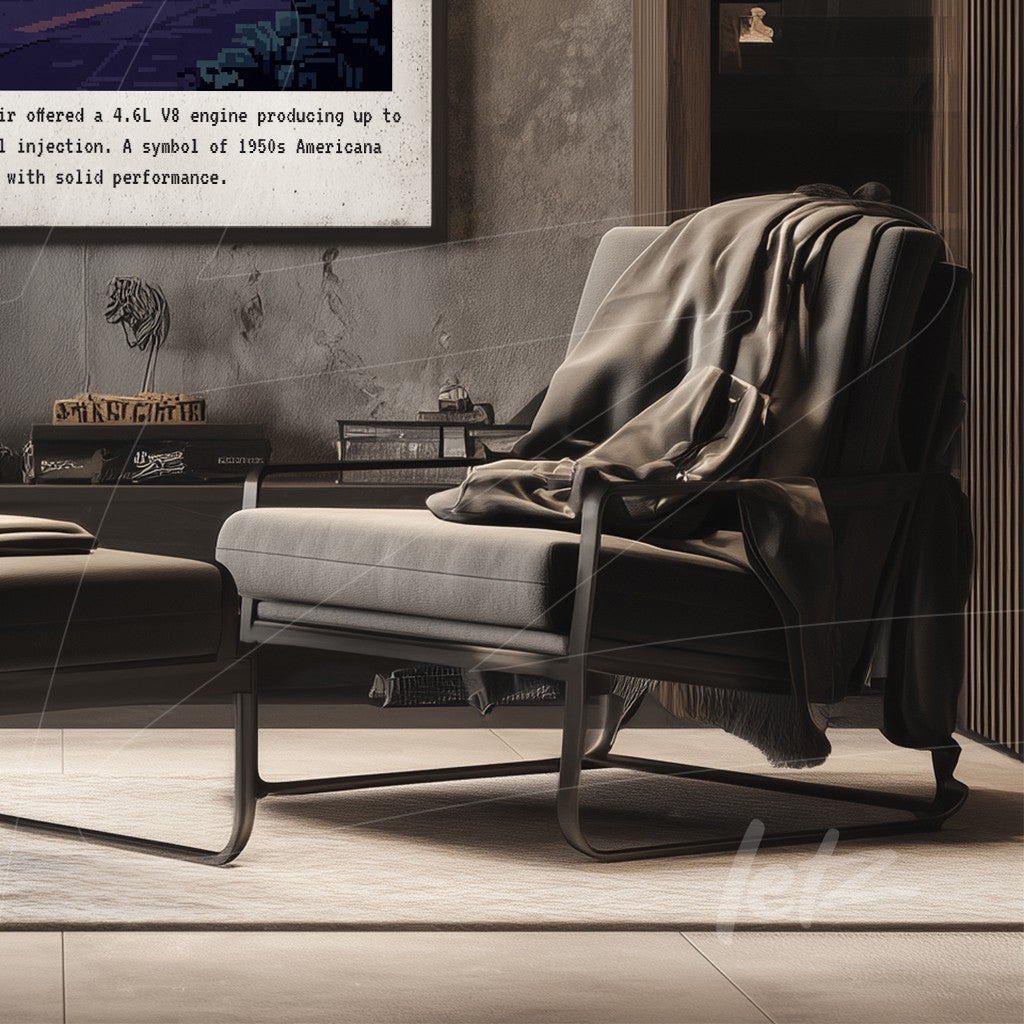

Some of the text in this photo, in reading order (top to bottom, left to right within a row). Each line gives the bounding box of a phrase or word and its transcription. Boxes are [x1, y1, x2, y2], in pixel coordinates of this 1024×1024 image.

[26, 107, 84, 123] offered
[93, 111, 103, 123] a
[113, 107, 152, 123] 4.6L
[161, 107, 180, 123] V8
[190, 107, 248, 127] engine
[257, 107, 344, 127] producing
[353, 111, 373, 127] up
[382, 107, 402, 123] to
[17, 138, 110, 158] injection.
[122, 138, 132, 154] A
[142, 138, 199, 158] symbol
[209, 138, 228, 154] of
[239, 138, 286, 154] 1950s
[296, 138, 382, 154] Americana
[7, 169, 45, 185] with
[55, 169, 103, 185] solid
[113, 169, 226, 189] performance.
